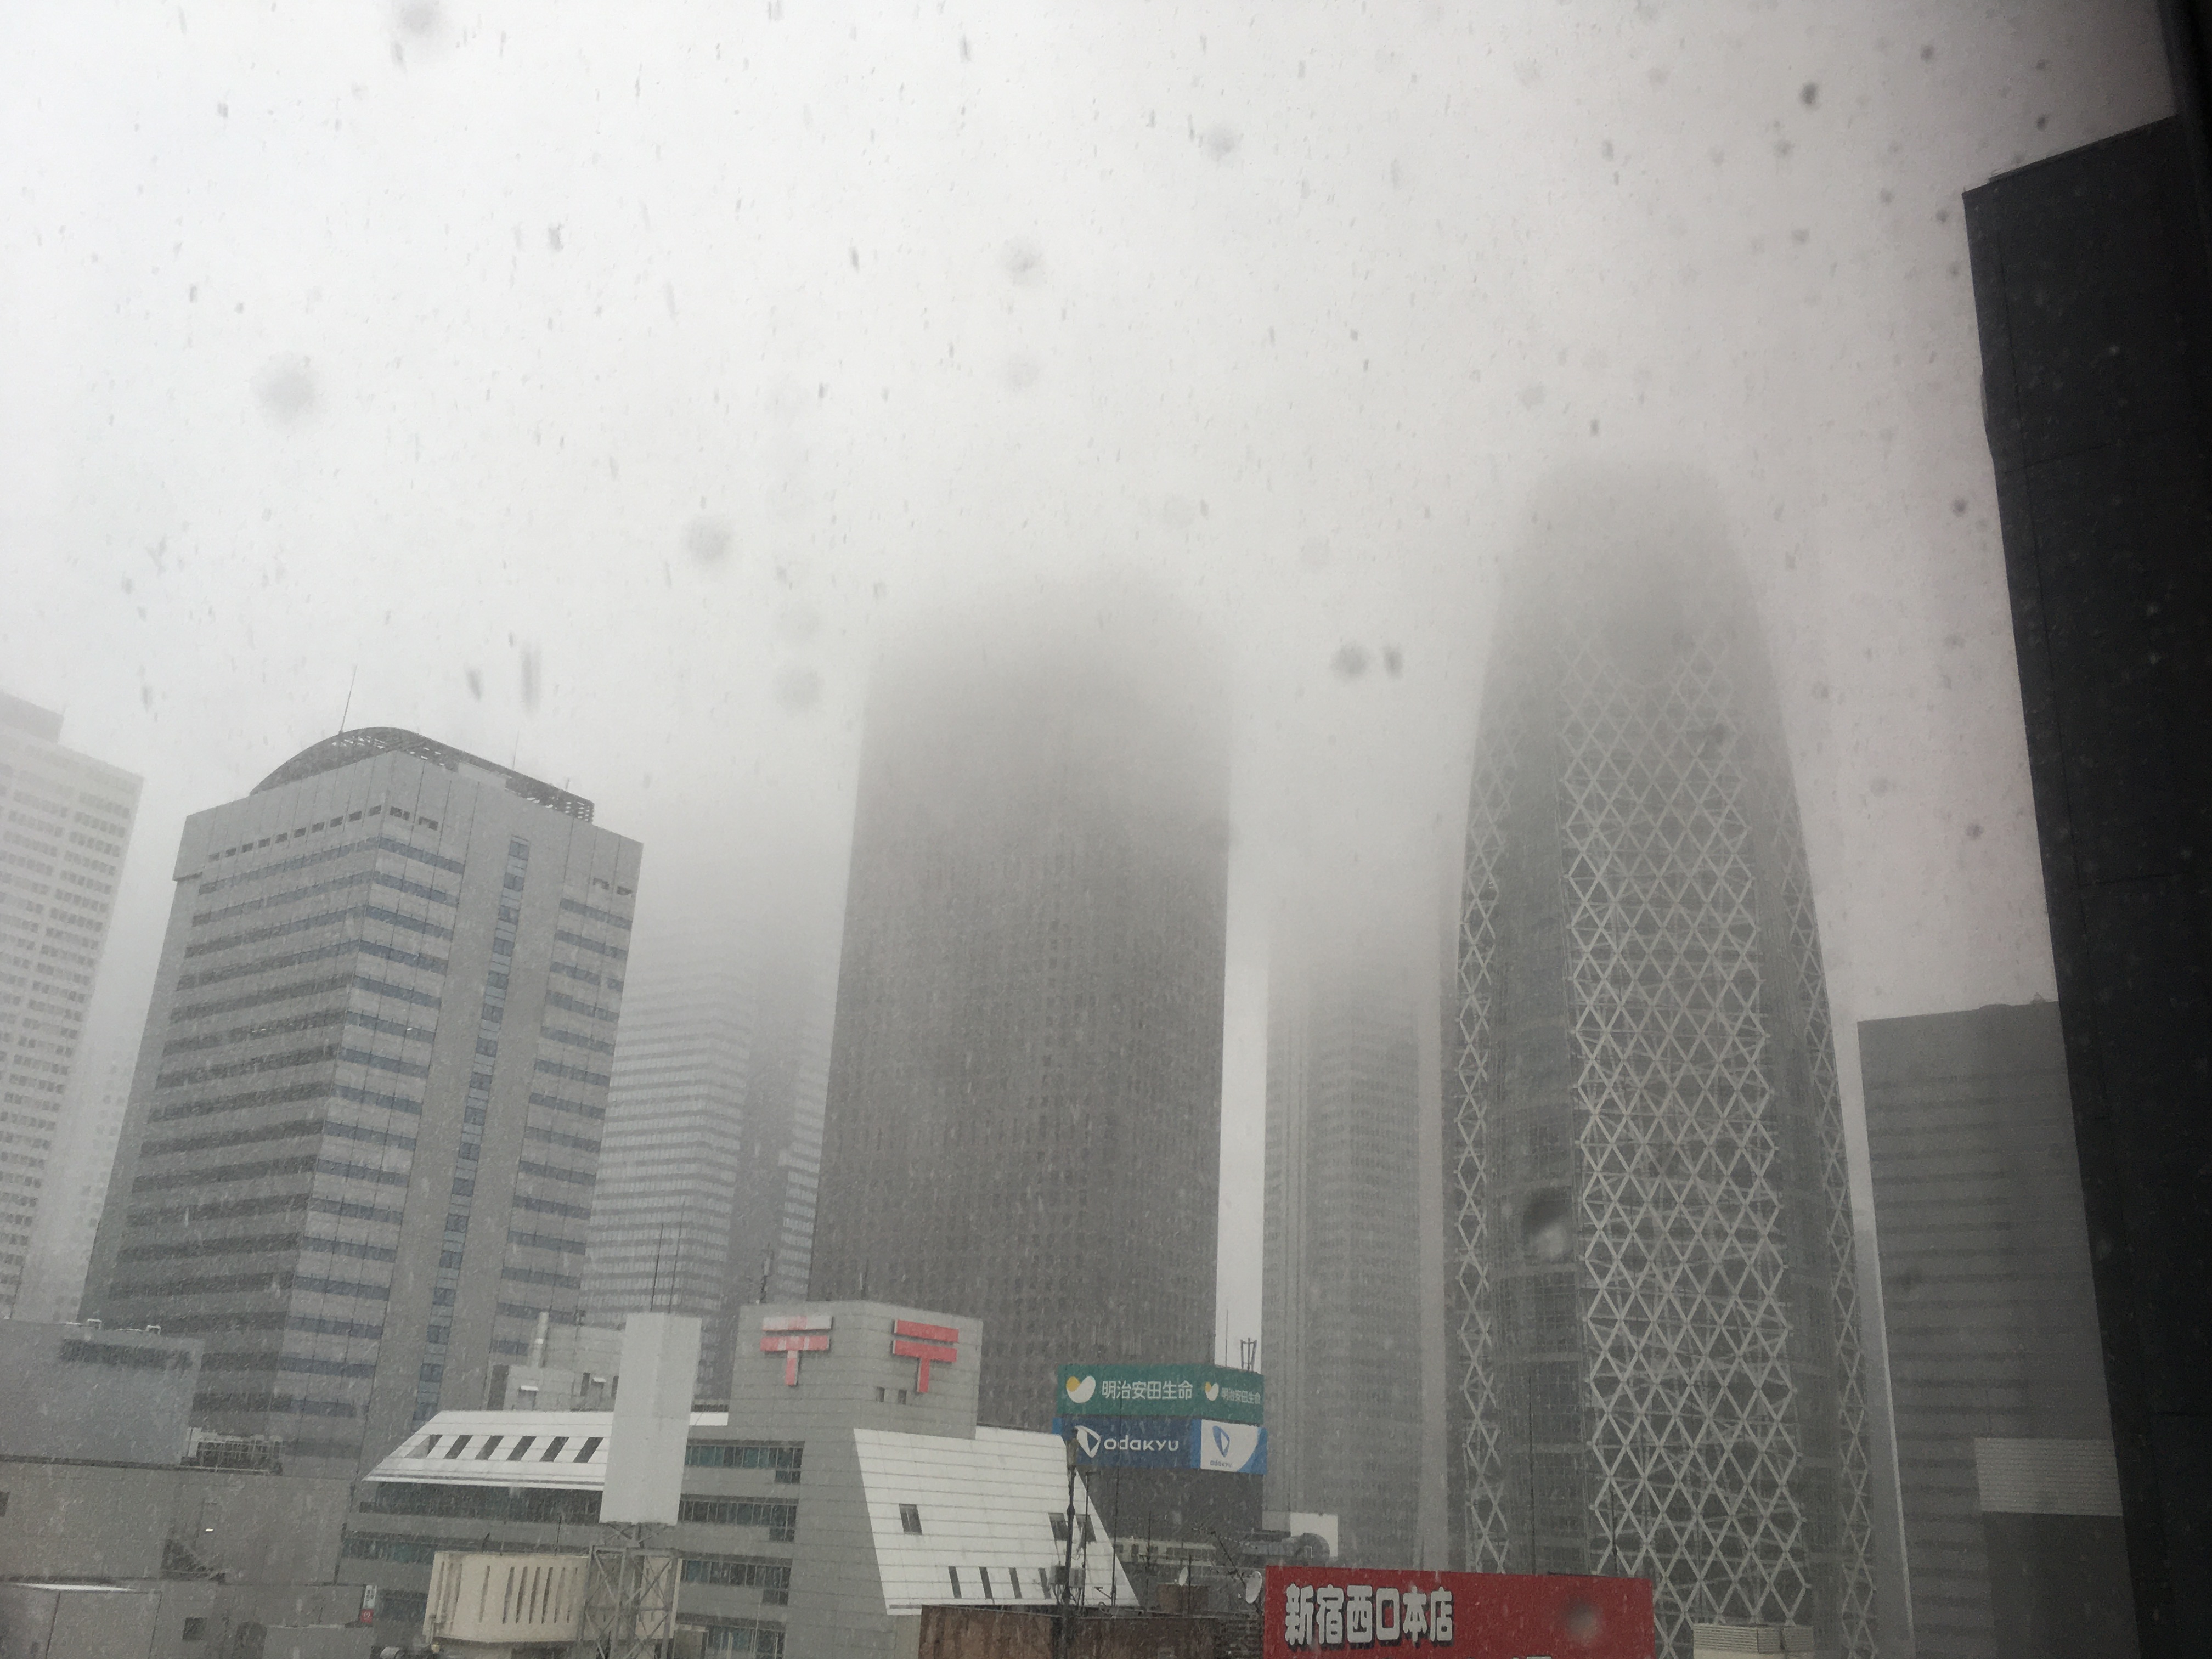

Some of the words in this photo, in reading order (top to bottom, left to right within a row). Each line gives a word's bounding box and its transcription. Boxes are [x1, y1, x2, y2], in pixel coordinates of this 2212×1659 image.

[1102, 1380, 1193, 1400] 明治安田生命
[1104, 1434, 1179, 1451] odakyu
[1285, 1583, 1452, 1646] 新宿西口本店
